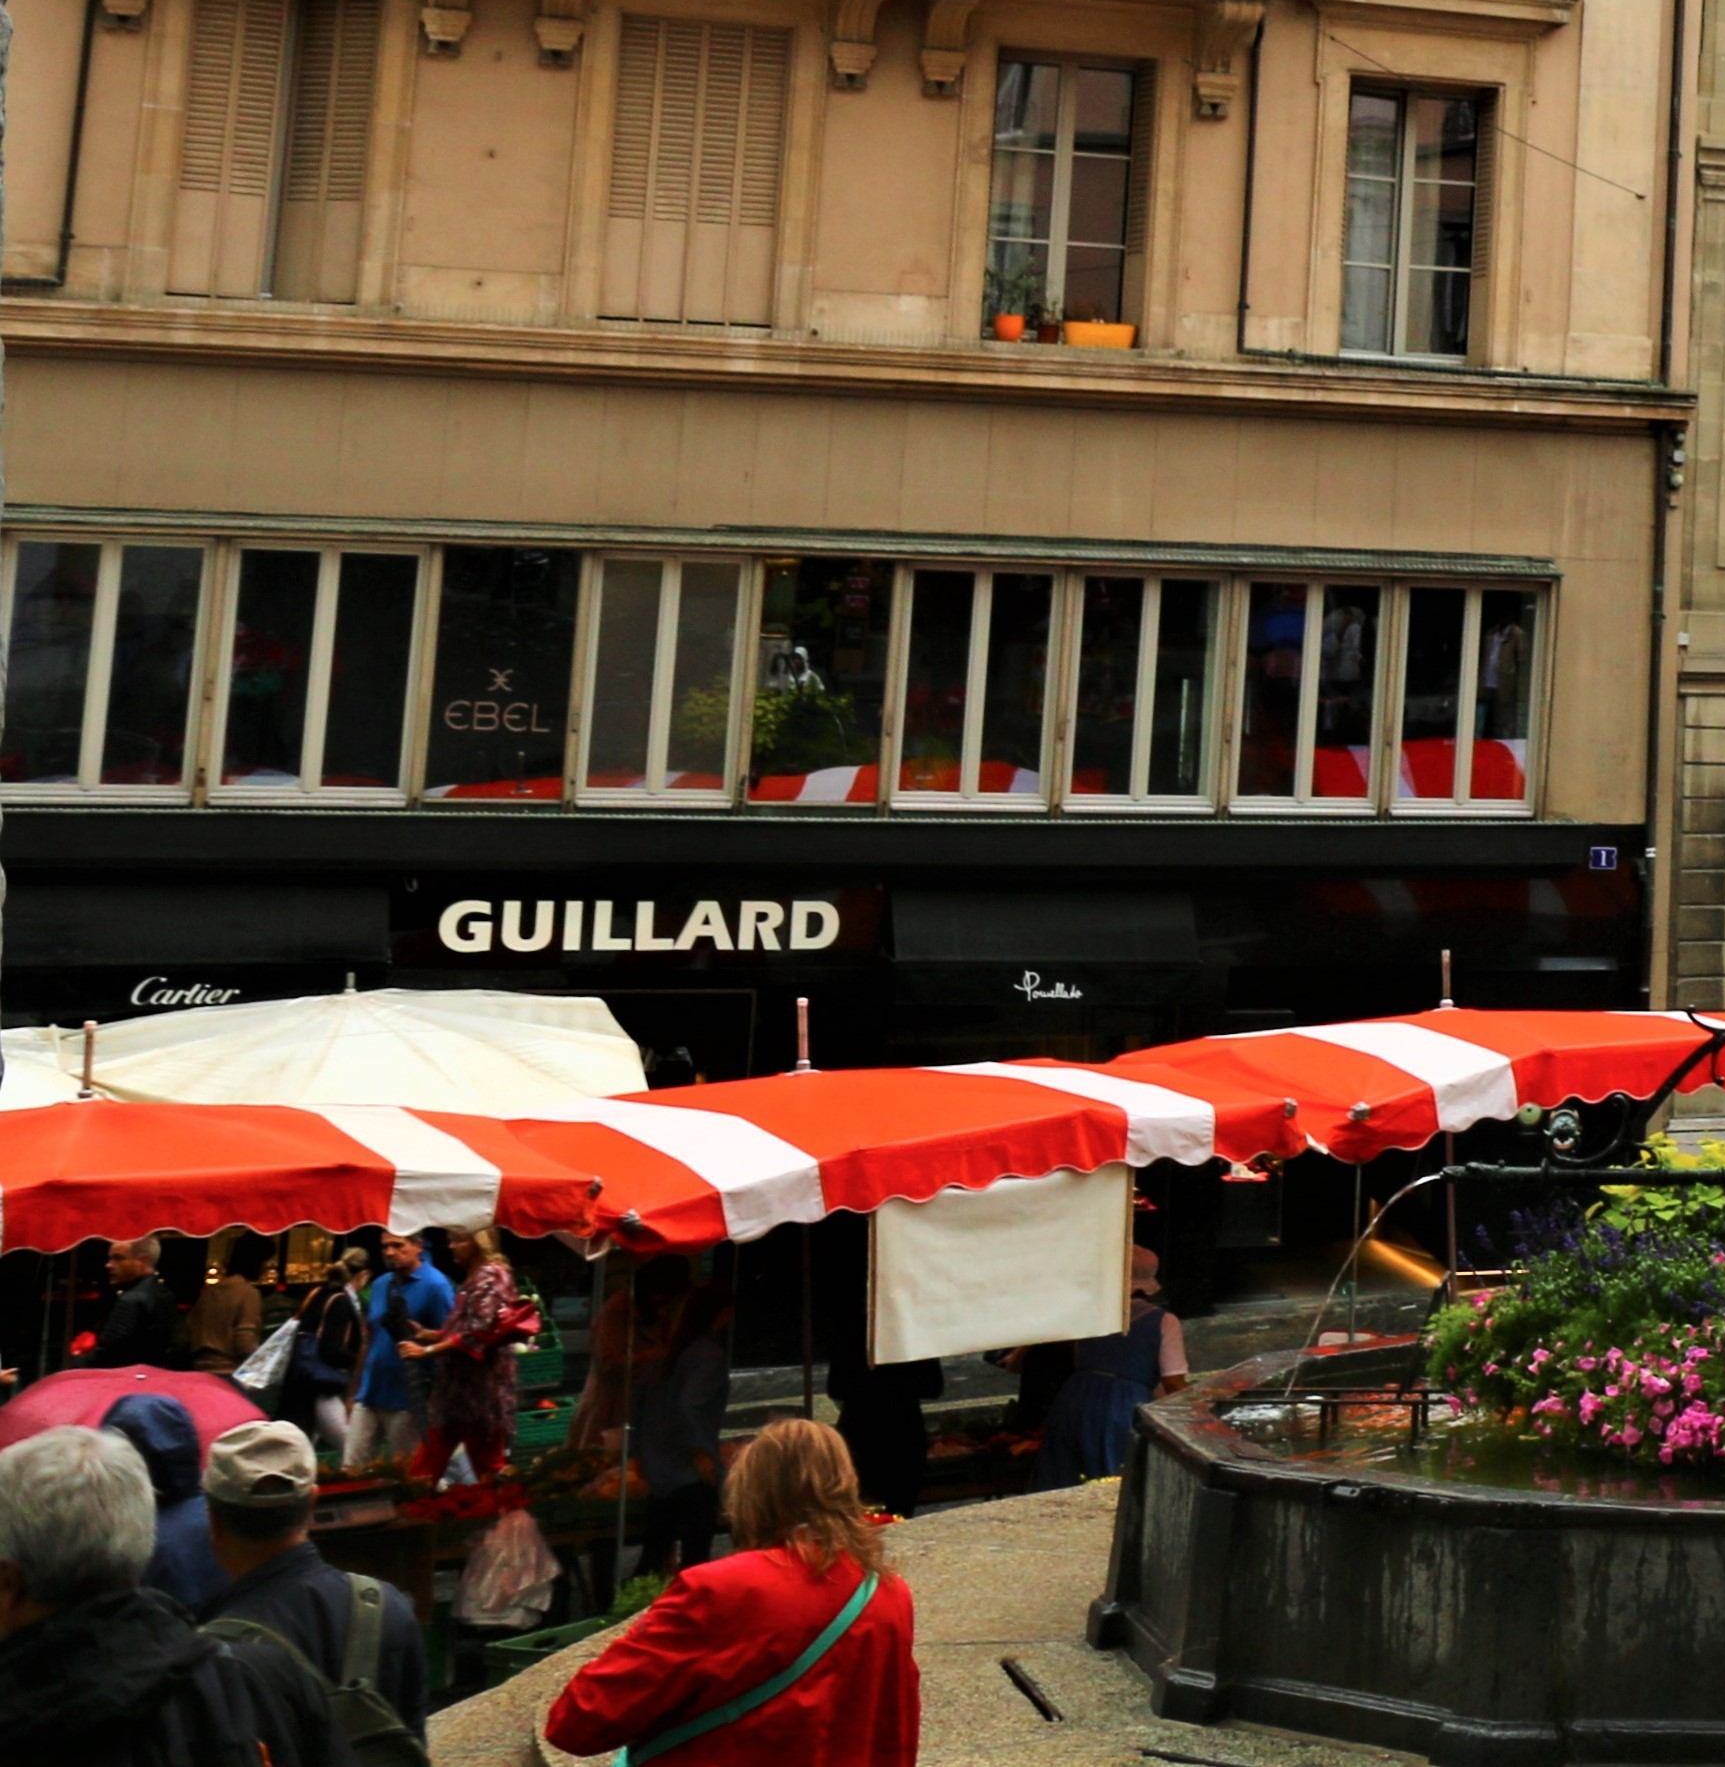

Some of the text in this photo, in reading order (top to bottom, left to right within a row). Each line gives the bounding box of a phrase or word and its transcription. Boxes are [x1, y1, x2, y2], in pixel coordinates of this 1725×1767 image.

[444, 700, 551, 732] EBEL
[1600, 849, 1607, 867] 1
[438, 899, 841, 954] GUILLARD
[130, 975, 241, 1006] Cartier
